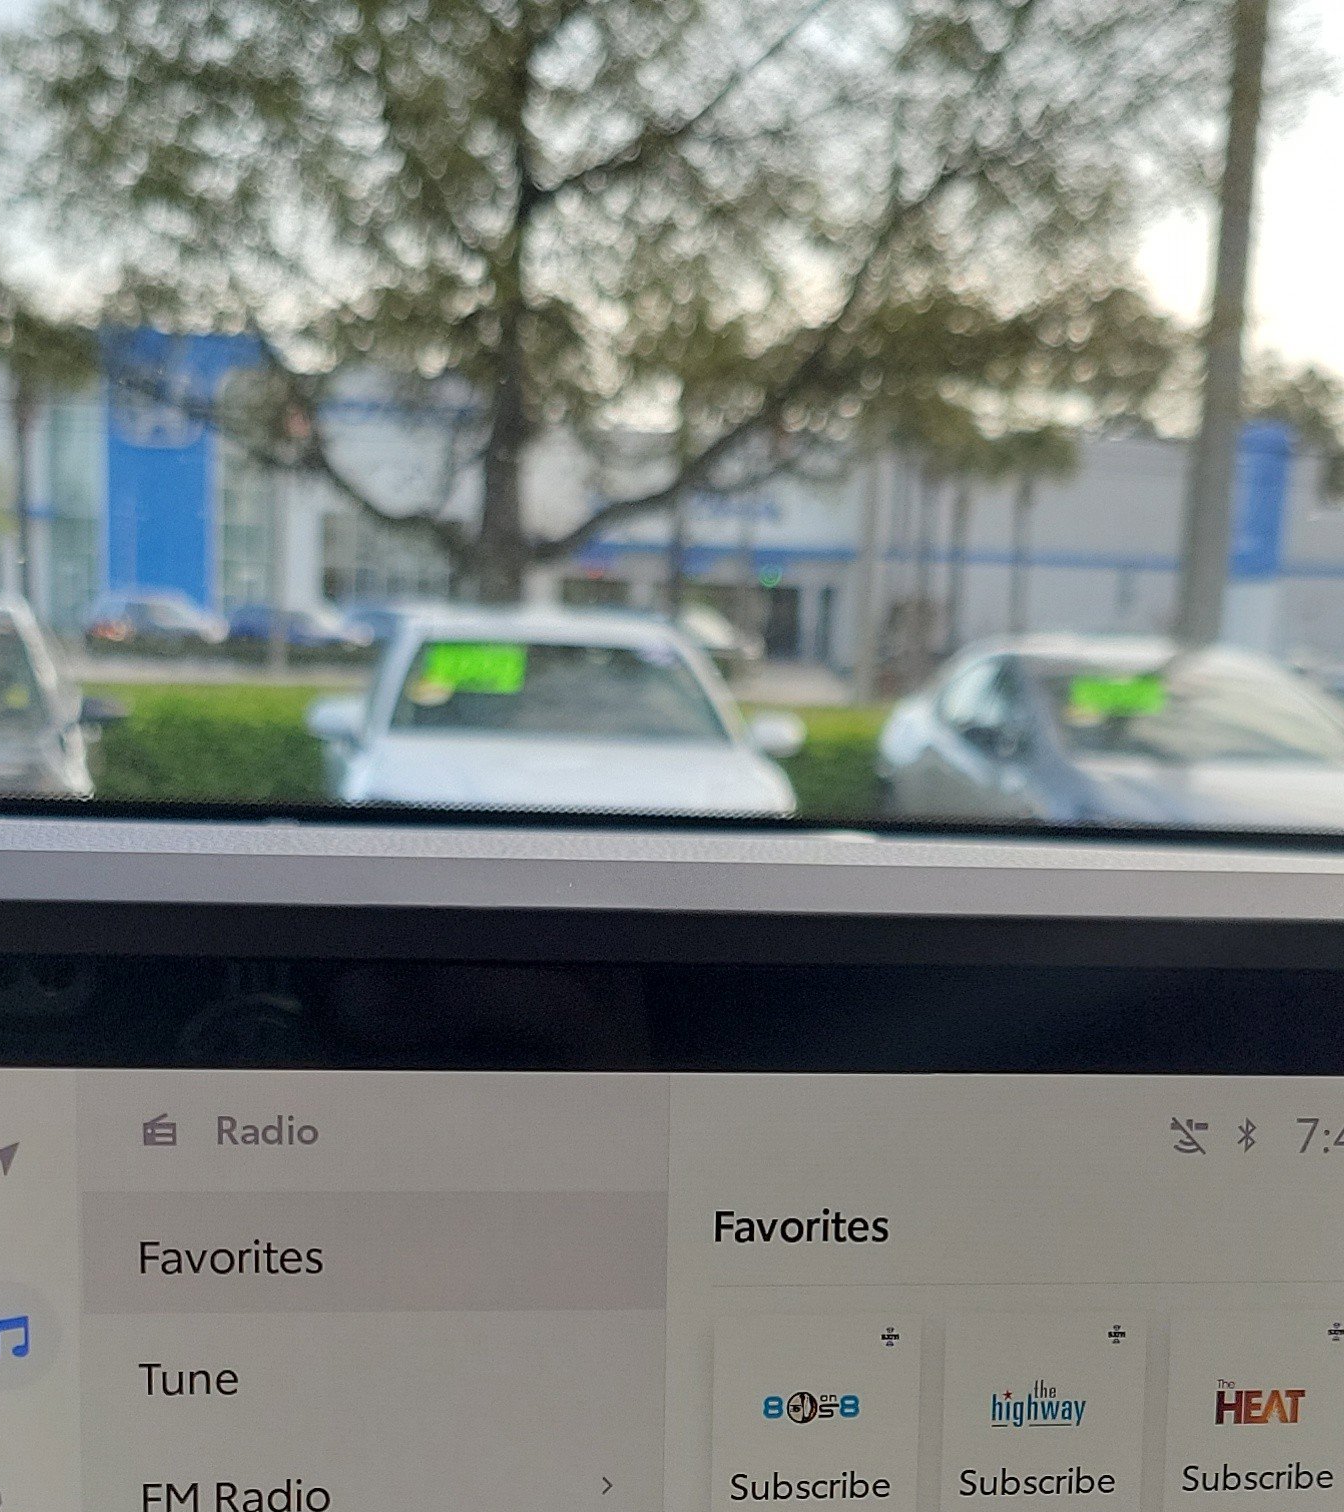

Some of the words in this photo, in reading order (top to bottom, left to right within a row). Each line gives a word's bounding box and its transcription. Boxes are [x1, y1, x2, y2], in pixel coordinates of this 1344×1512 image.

[218, 1115, 318, 1145] Radio
[715, 1208, 888, 1243] Favorites
[140, 1239, 322, 1274] Favorites
[139, 1364, 238, 1396] Tune
[1033, 1380, 1057, 1399] the
[1218, 1379, 1235, 1389] The
[992, 1393, 1086, 1427] highway
[1215, 1390, 1305, 1424] HEAT
[731, 1471, 890, 1500] Subscribe
[960, 1467, 1115, 1495] Subscribe
[1182, 1462, 1333, 1491] Subscribe
